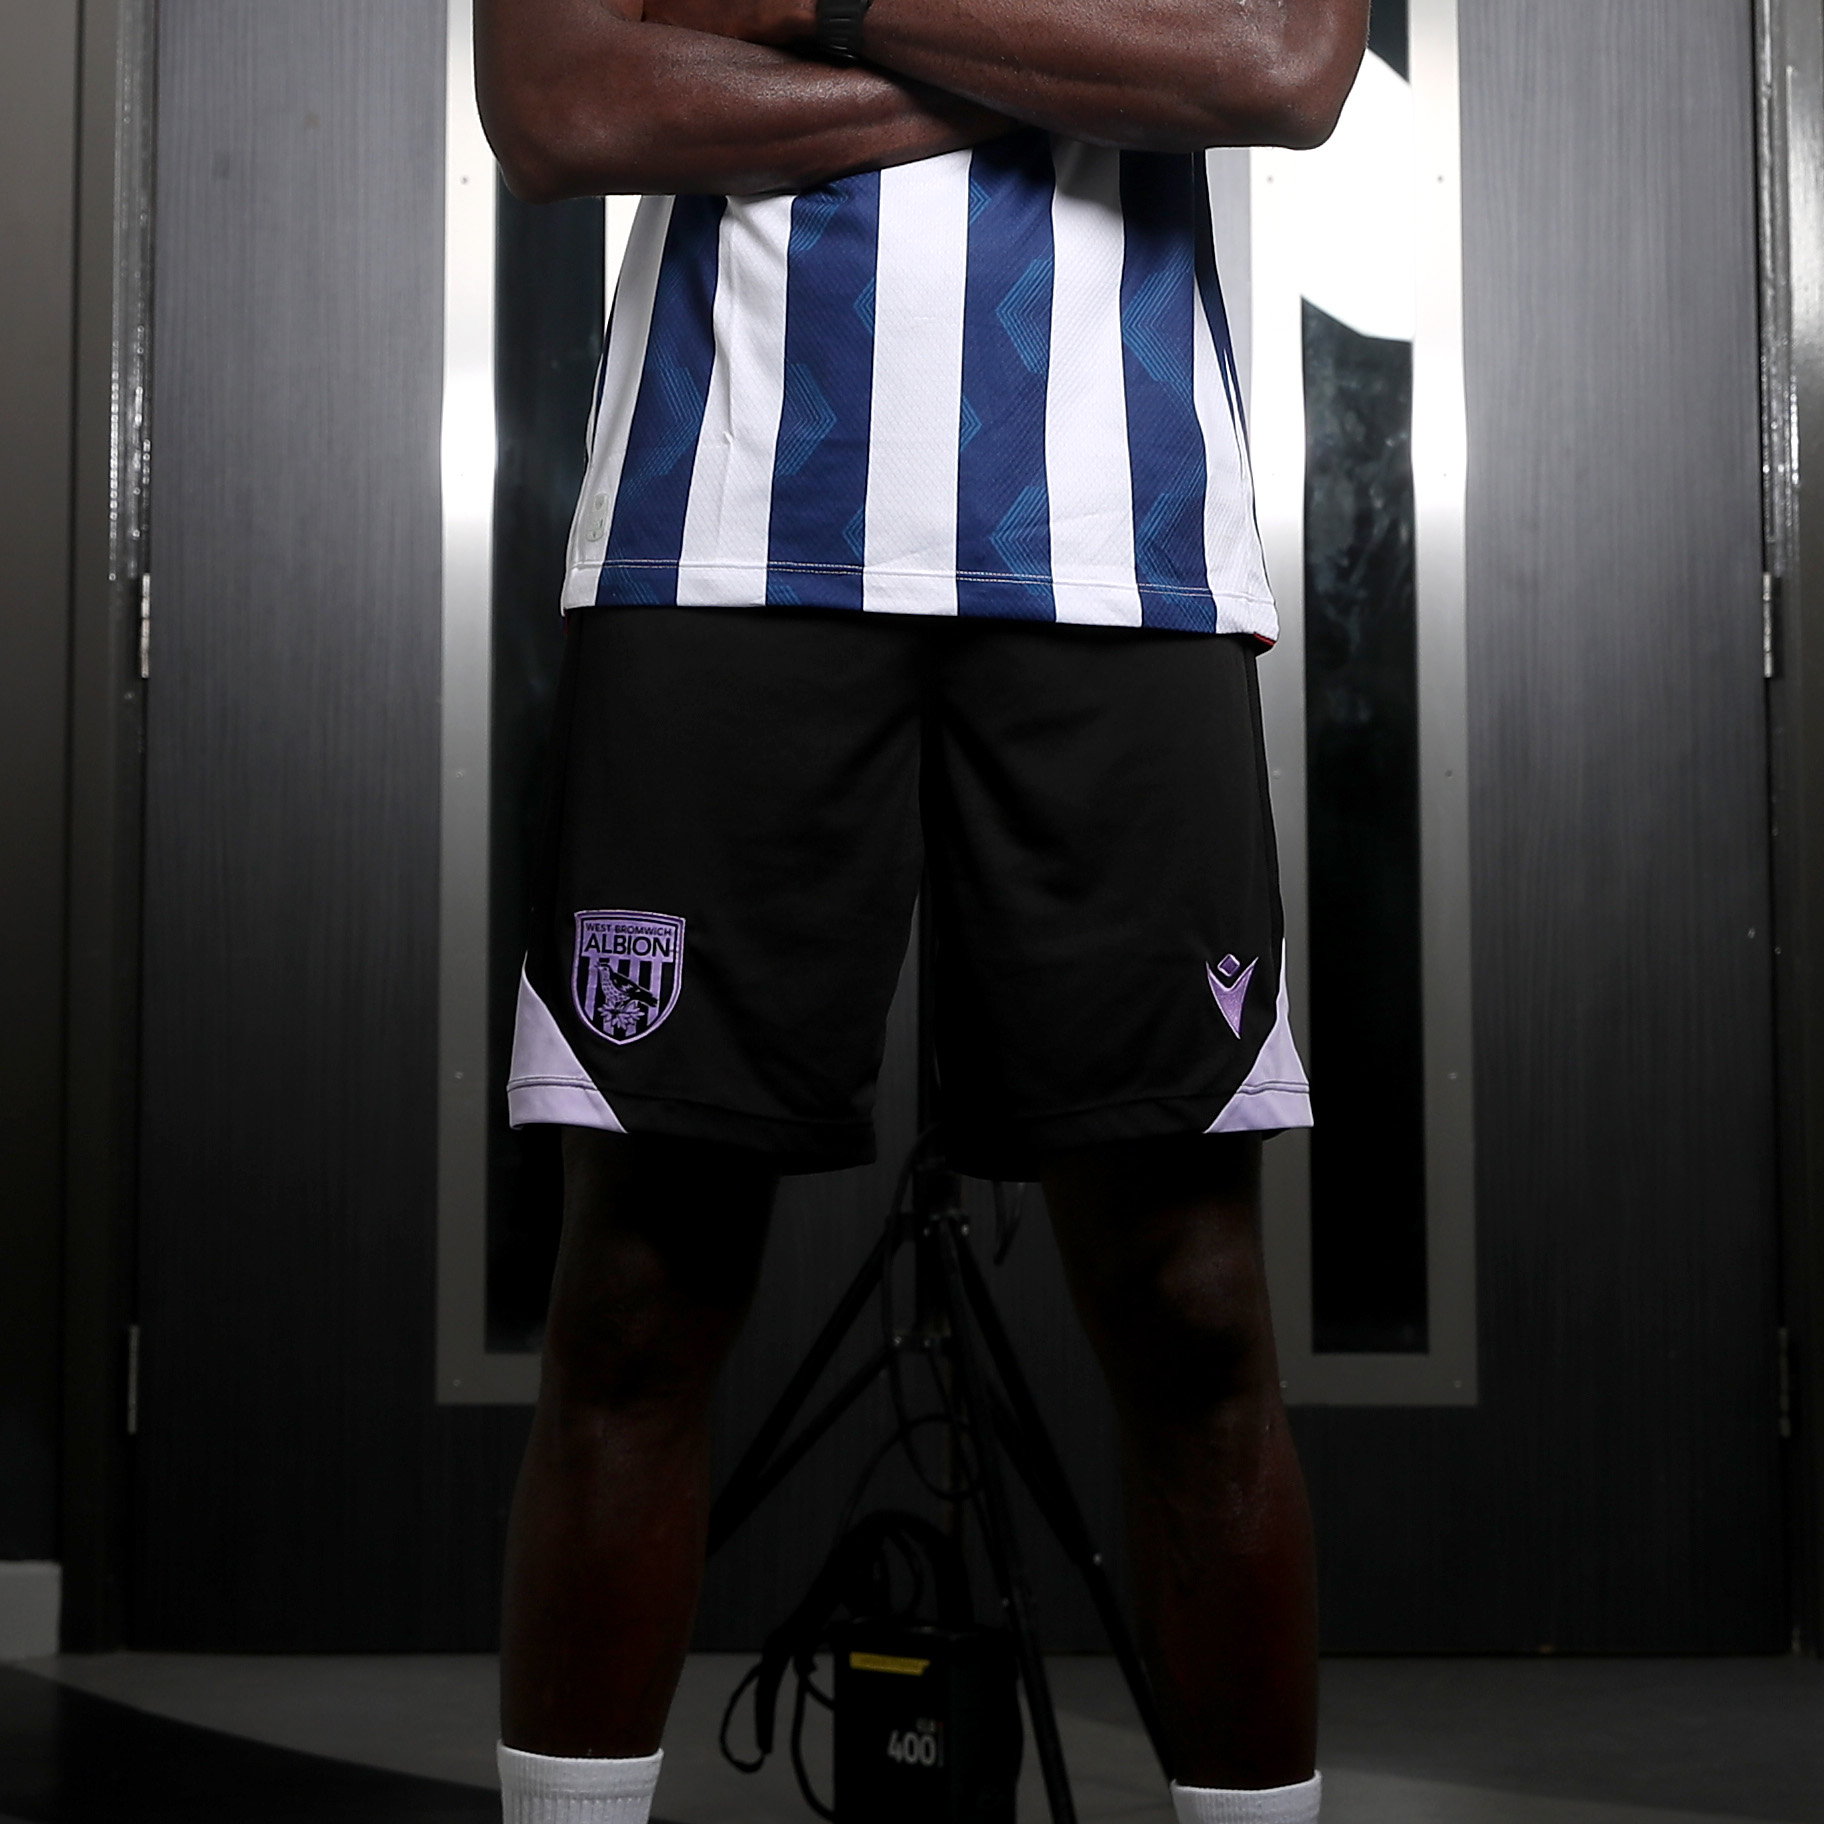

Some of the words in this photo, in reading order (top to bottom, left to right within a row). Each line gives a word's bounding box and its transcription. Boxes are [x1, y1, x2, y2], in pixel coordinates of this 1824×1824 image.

[585, 923, 612, 933] WEST
[614, 925, 672, 937] BROMWICH
[584, 933, 670, 958] ALBION
[886, 1728, 937, 1768] 400
